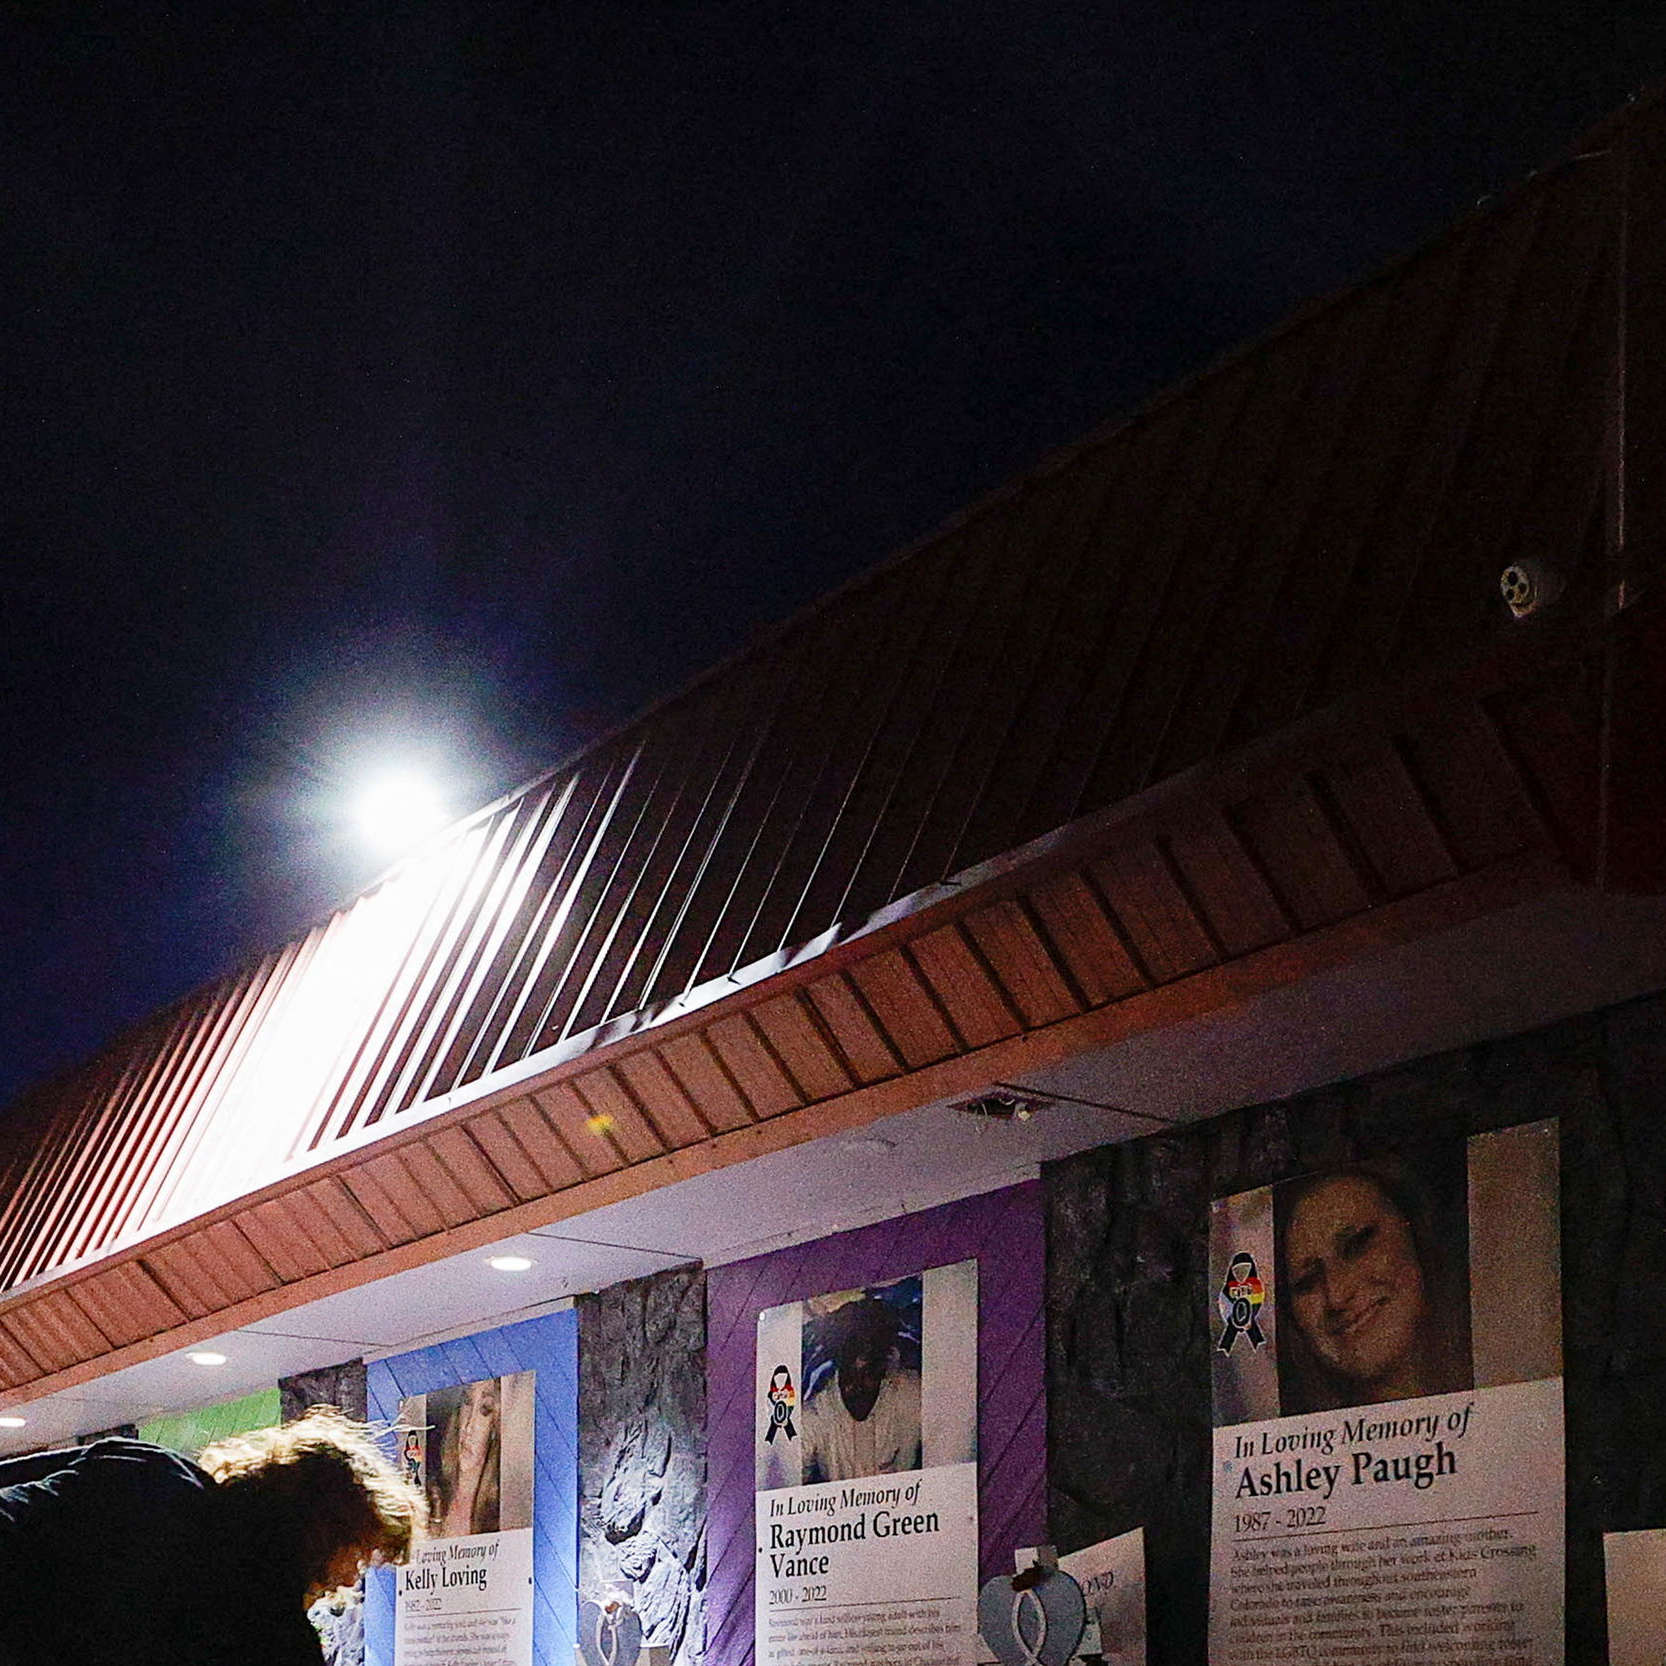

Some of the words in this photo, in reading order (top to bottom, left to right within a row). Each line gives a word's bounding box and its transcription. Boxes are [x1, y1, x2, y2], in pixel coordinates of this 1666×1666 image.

[1235, 1436, 1254, 1458] In
[1262, 1426, 1337, 1455] Loving
[1342, 1414, 1440, 1444] Memory
[1447, 1401, 1475, 1438] of
[1235, 1459, 1342, 1499] Ashley
[1351, 1441, 1456, 1490] Paugh
[770, 1499, 784, 1517] In
[787, 1493, 836, 1517] Loving
[840, 1488, 901, 1509] Memory
[905, 1478, 923, 1505] of
[770, 1513, 866, 1555] Raymond
[873, 1511, 940, 1538] Green
[1234, 1511, 1271, 1533] 1987
[1287, 1506, 1326, 1528] 2022
[416, 1547, 447, 1566] Loving
[449, 1544, 486, 1563] Memory
[489, 1539, 501, 1561] of
[770, 1553, 830, 1578] Vance
[406, 1567, 438, 1595] Kelly
[442, 1564, 487, 1591] Loving
[769, 1588, 792, 1605] 2000
[802, 1585, 827, 1603] 2022
